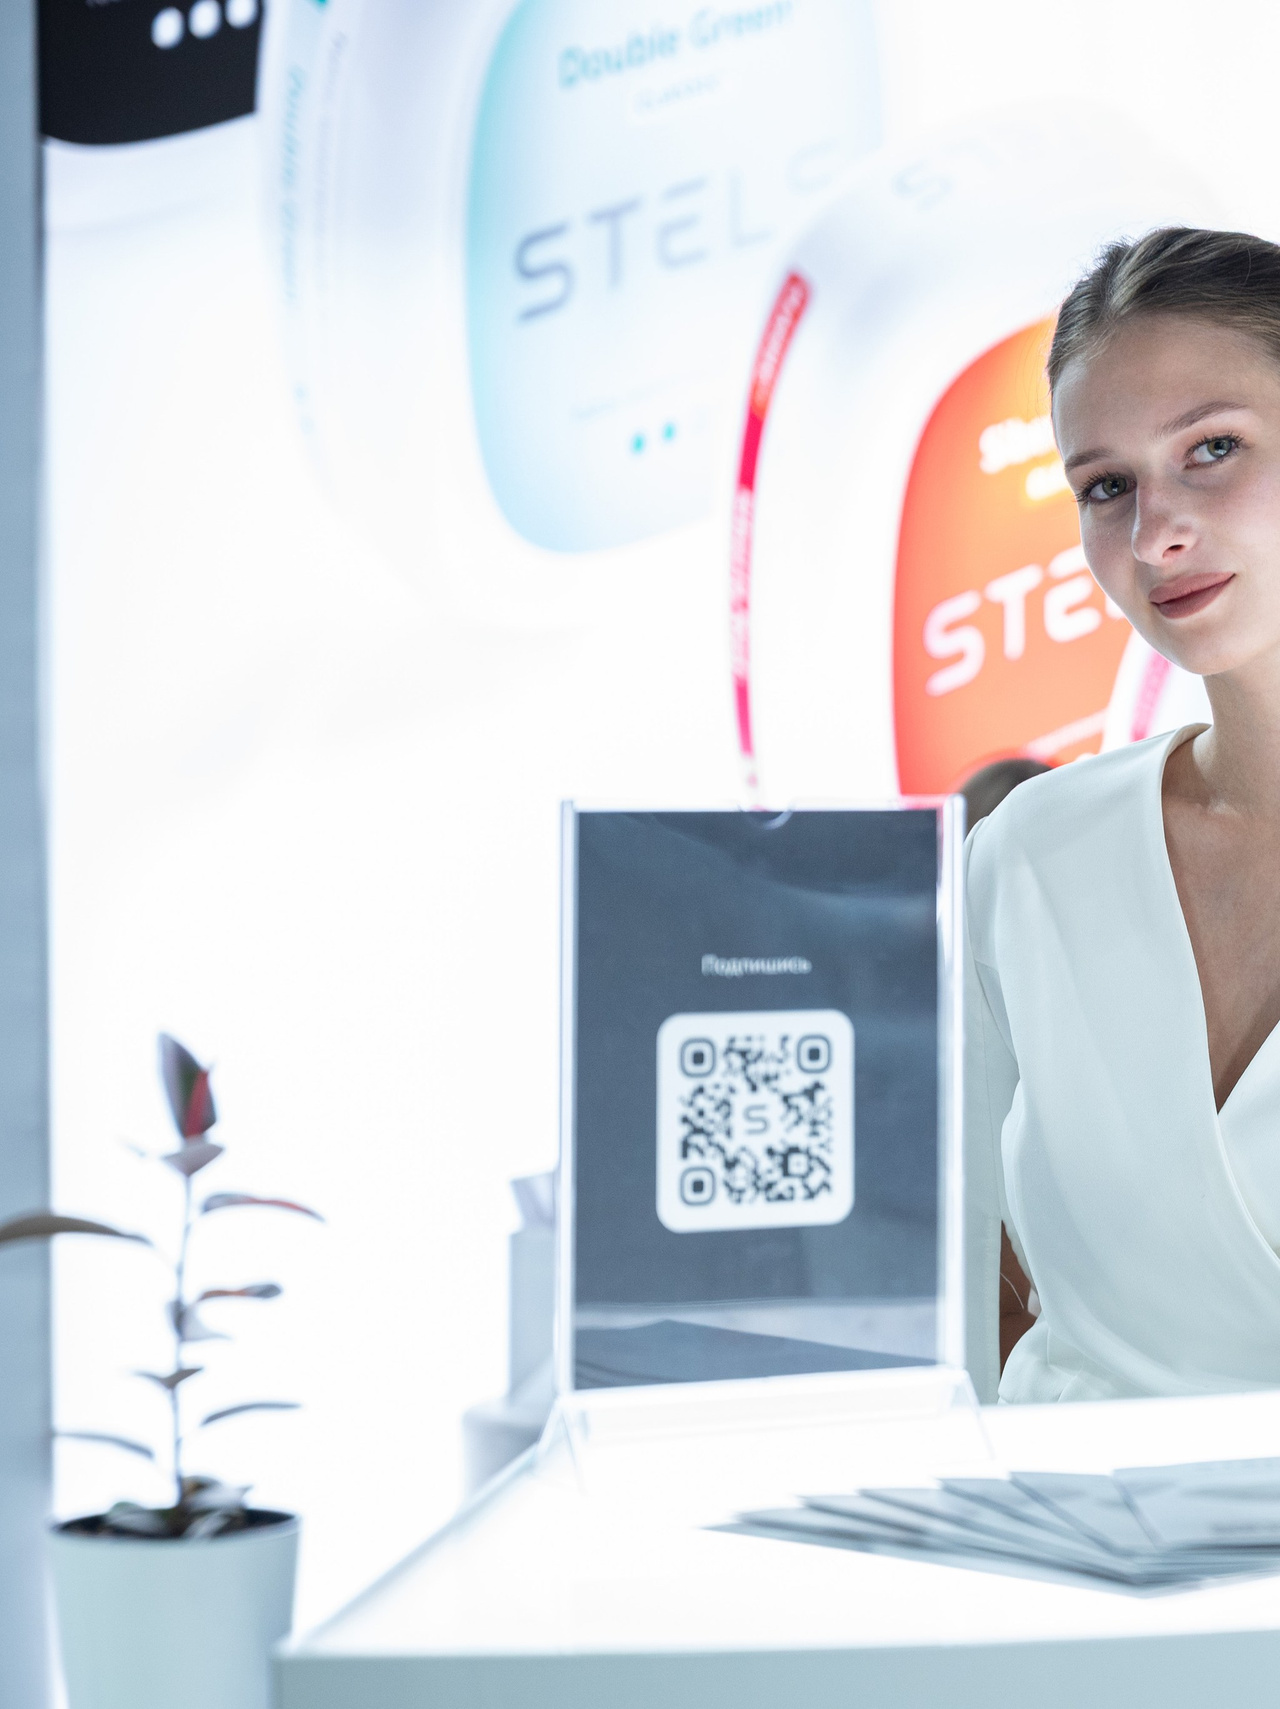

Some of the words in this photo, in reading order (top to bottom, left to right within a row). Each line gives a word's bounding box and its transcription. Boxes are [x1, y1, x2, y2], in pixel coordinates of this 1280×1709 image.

[557, 20, 682, 91] Double
[687, 0, 794, 51] Green
[922, 544, 1125, 697] STE
[701, 953, 812, 978] Подпишись
